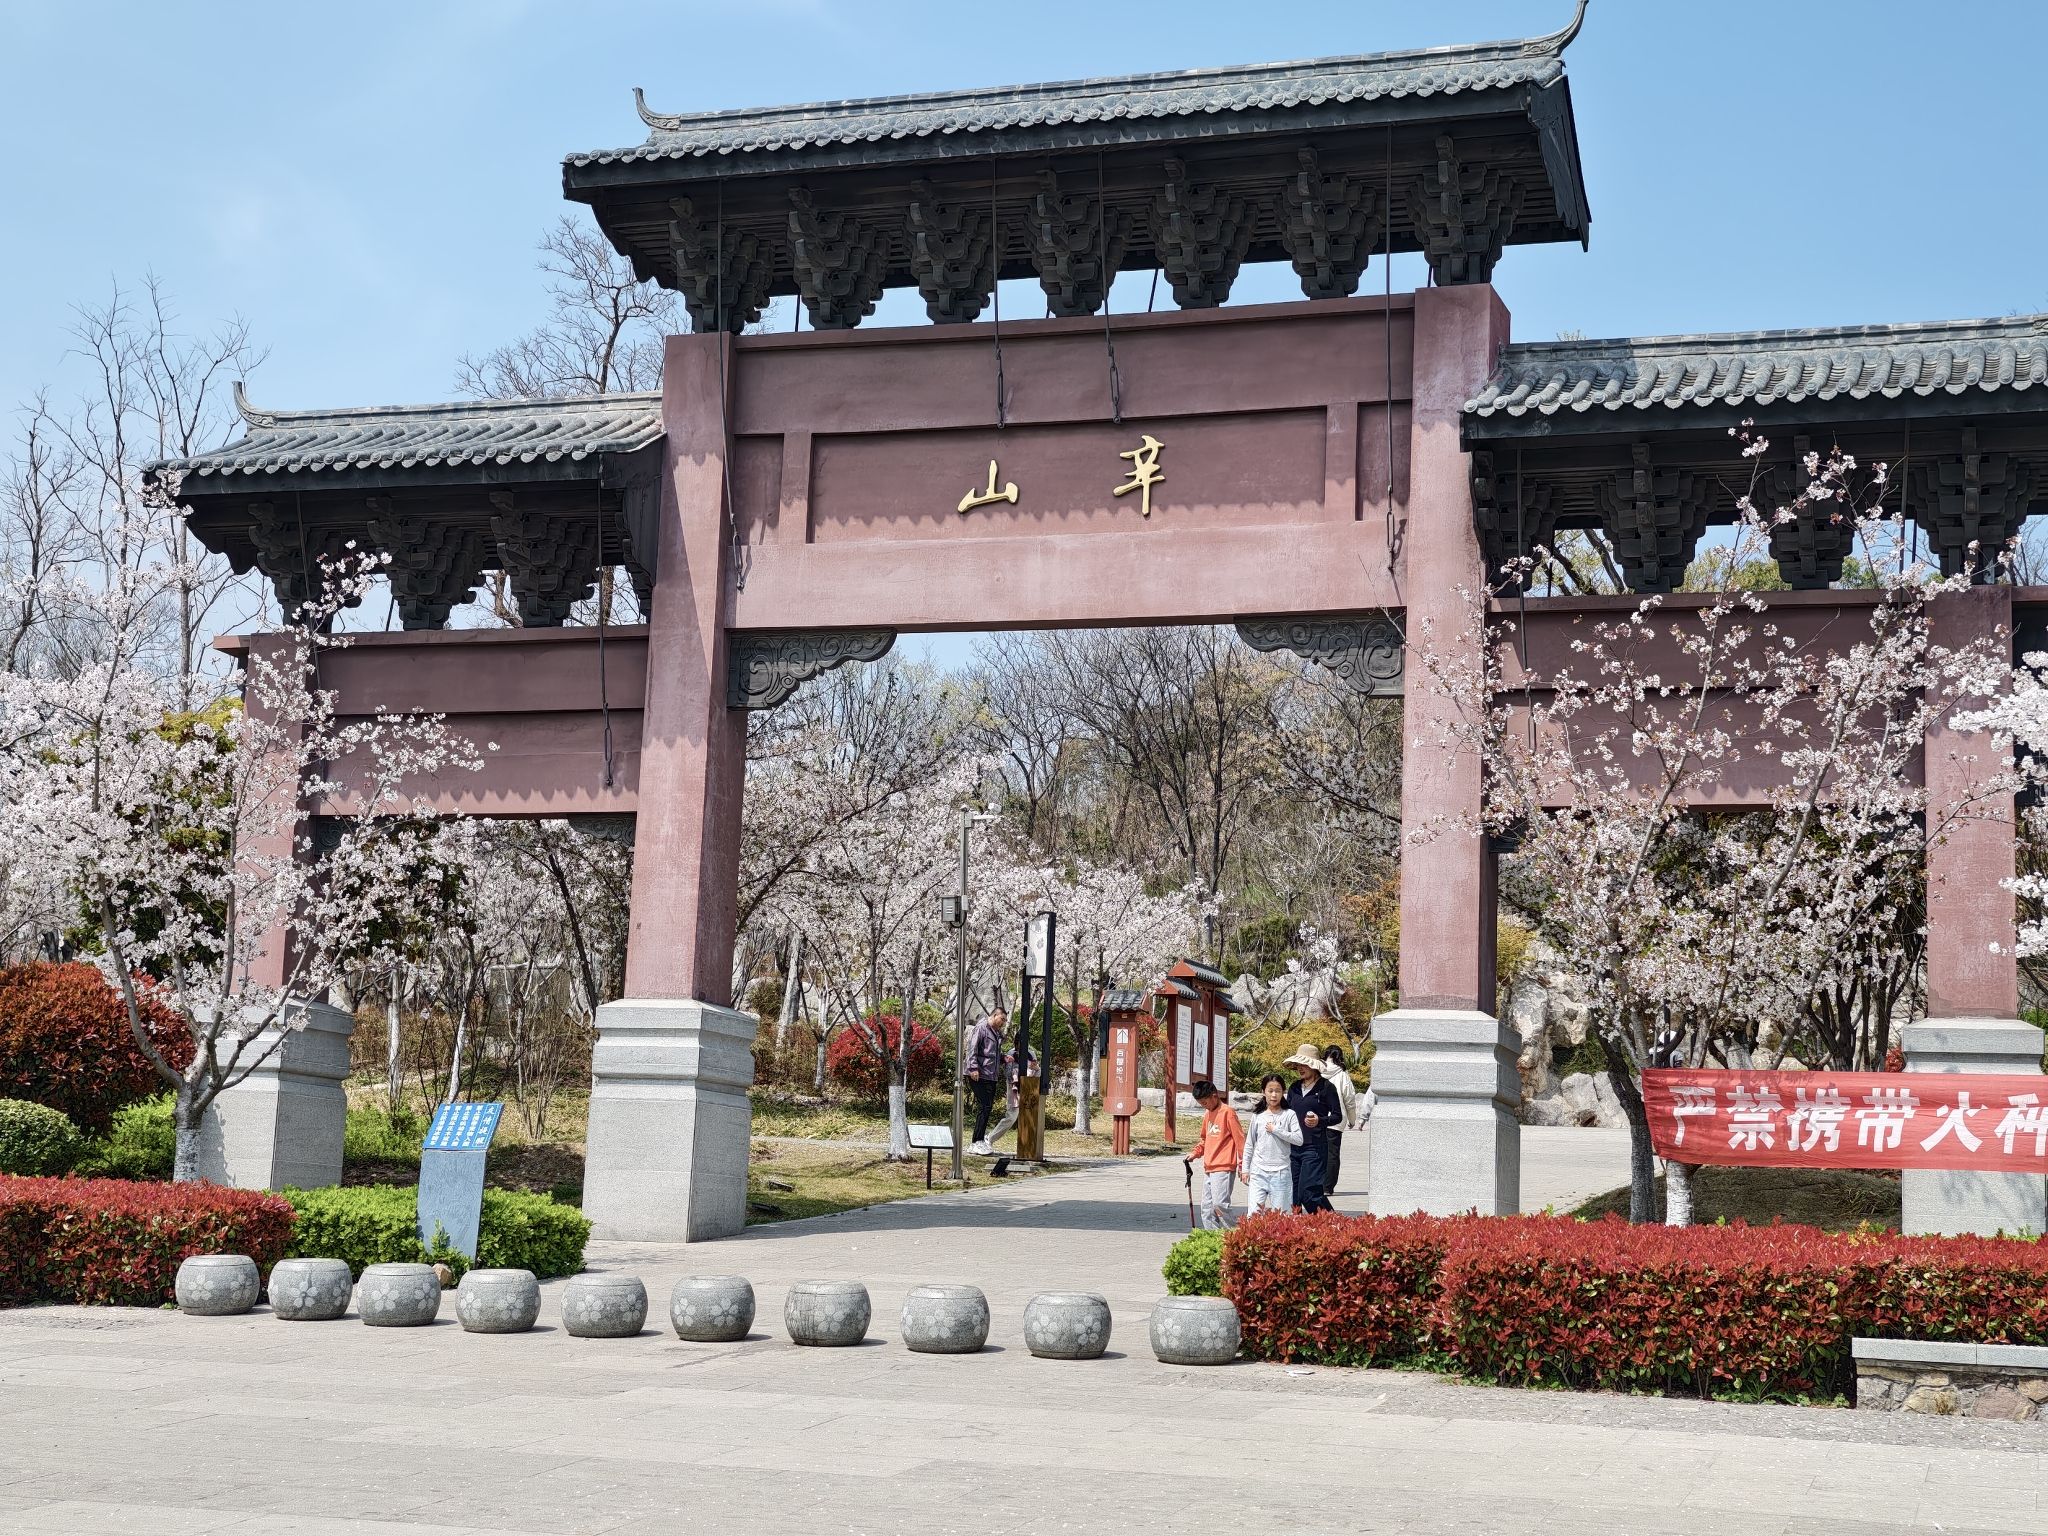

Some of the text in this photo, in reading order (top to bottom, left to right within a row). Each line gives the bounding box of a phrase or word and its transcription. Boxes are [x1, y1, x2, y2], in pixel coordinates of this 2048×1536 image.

[1668, 1085, 2048, 1157] 严禁携带火种
